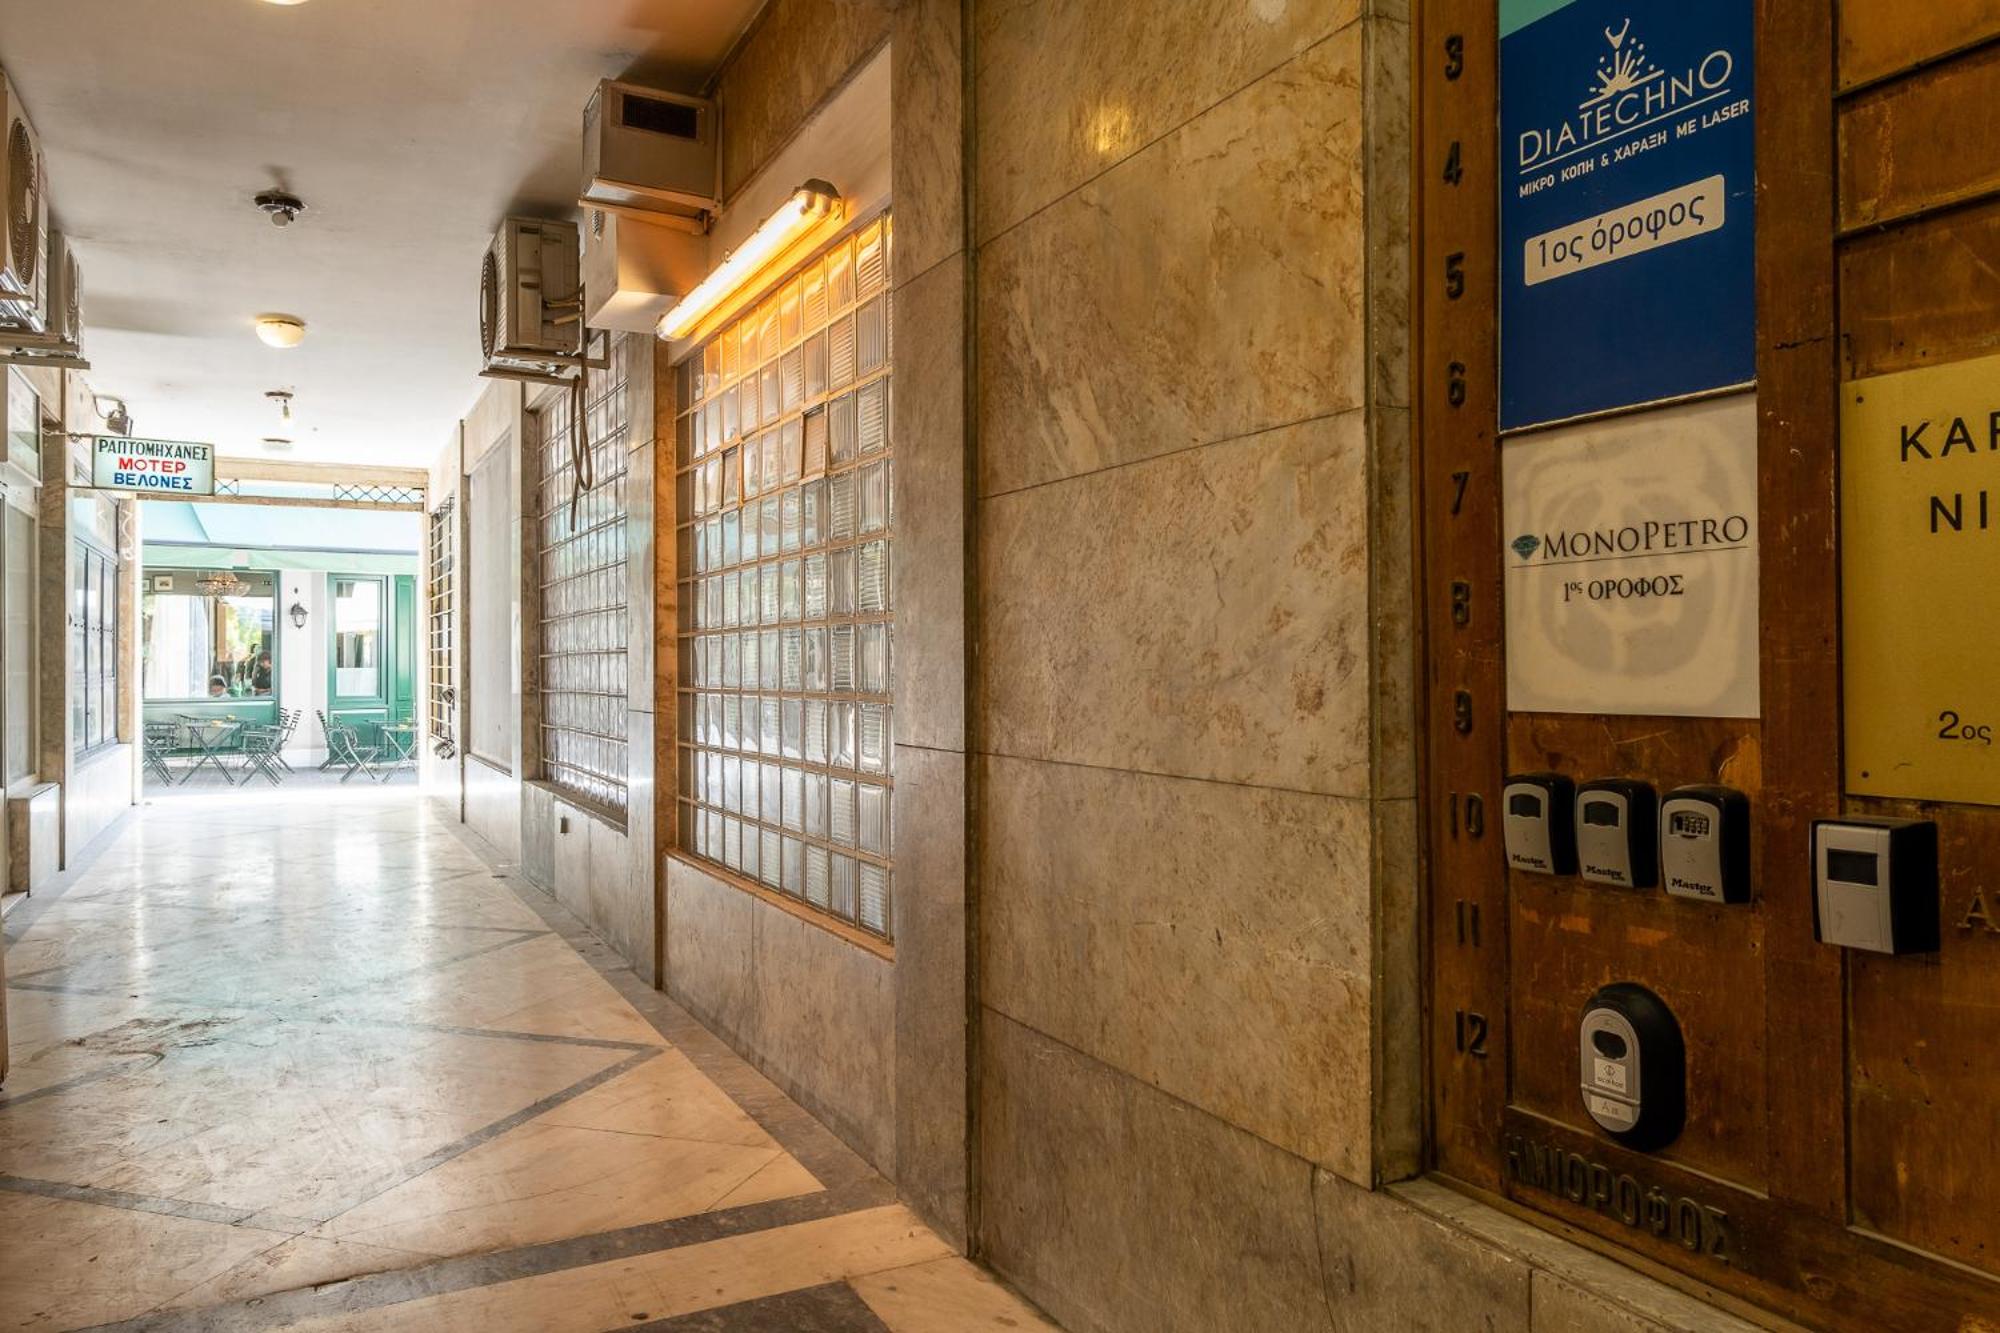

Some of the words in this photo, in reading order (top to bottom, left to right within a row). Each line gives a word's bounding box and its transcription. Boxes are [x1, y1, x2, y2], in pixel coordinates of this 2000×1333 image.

[1445, 35, 1463, 81] 3
[1520, 50, 1733, 166] DIATECHNO
[1443, 142, 1462, 187] 4
[1519, 174, 1555, 198] ΜΙΚΡΟ
[1561, 158, 1595, 182] ΚΟΠΗ
[1600, 153, 1609, 167] &
[1613, 130, 1667, 162] ΧΑΡΑΞΗ
[1676, 119, 1697, 139] ΜΕ
[1702, 99, 1749, 129] LASER
[1538, 233, 1583, 268] 1ος
[1591, 194, 1706, 257] όροφος
[1445, 252, 1465, 299] 5
[1447, 361, 1466, 409] 6
[98, 439, 209, 461] ΡΑΠΤΟΜΗΧΑΝΕΣ
[118, 457, 186, 474] ΜΟΤΕΡ
[113, 472, 193, 490] ΒΕΛΟΝΕΣ
[1451, 471, 1469, 516] 7
[1450, 581, 1470, 626] 8
[1588, 575, 1684, 601] ΟΡΟΦΟΣ
[1453, 689, 1473, 734] 9
[1939, 711, 1991, 745] 2ος
[1449, 792, 1485, 840] 10
[1455, 900, 1481, 948] 11
[1455, 1010, 1489, 1059] 12
